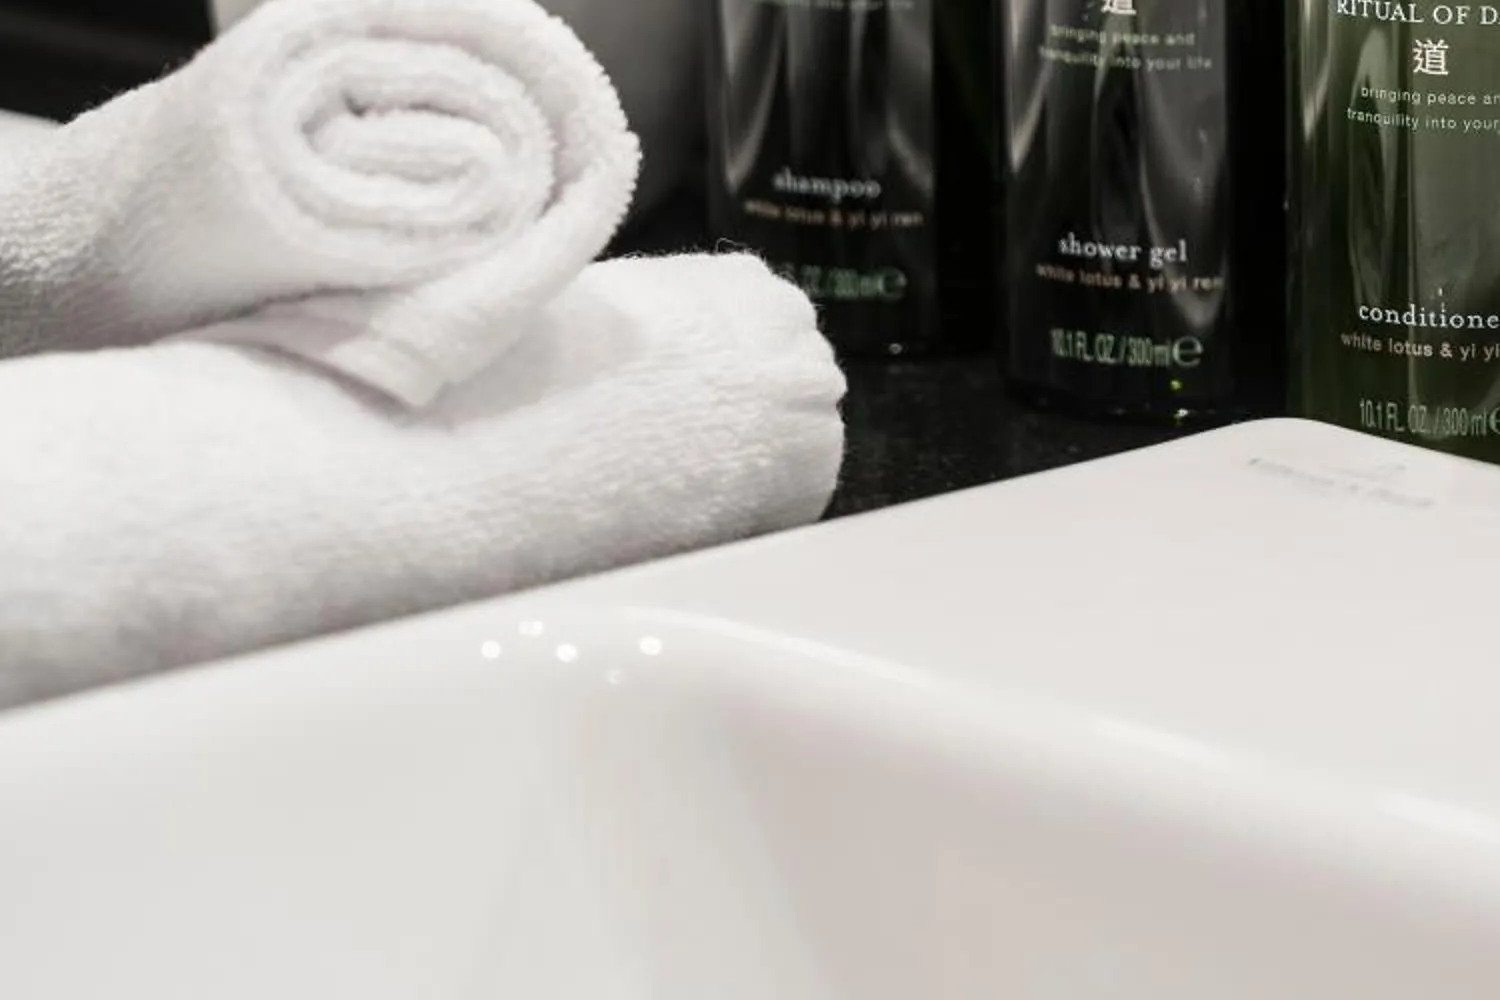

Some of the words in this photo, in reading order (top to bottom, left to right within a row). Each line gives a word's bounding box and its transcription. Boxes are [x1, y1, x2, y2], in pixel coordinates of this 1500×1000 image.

[1433, 5, 1472, 26] OF
[1165, 31, 1196, 47] and
[1147, 57, 1182, 73] your
[1412, 38, 1449, 76] 道
[1361, 86, 1422, 105] bringing
[1427, 92, 1477, 106] peace
[1347, 106, 1419, 129] tranquility
[1425, 116, 1458, 130] into
[1463, 117, 1500, 133] your
[773, 165, 882, 204] shampoo
[1059, 232, 1142, 261] shower
[1150, 239, 1188, 268] gel
[1080, 269, 1123, 289] lotus
[1127, 273, 1142, 289] &
[1146, 274, 1164, 293] yi
[1340, 331, 1383, 352] white
[1388, 338, 1433, 357] lotus
[1439, 341, 1454, 358] &
[1459, 343, 1476, 362] yi
[1483, 343, 1500, 362] yi
[1443, 407, 1468, 437] 300
[1471, 407, 1487, 437] ml
